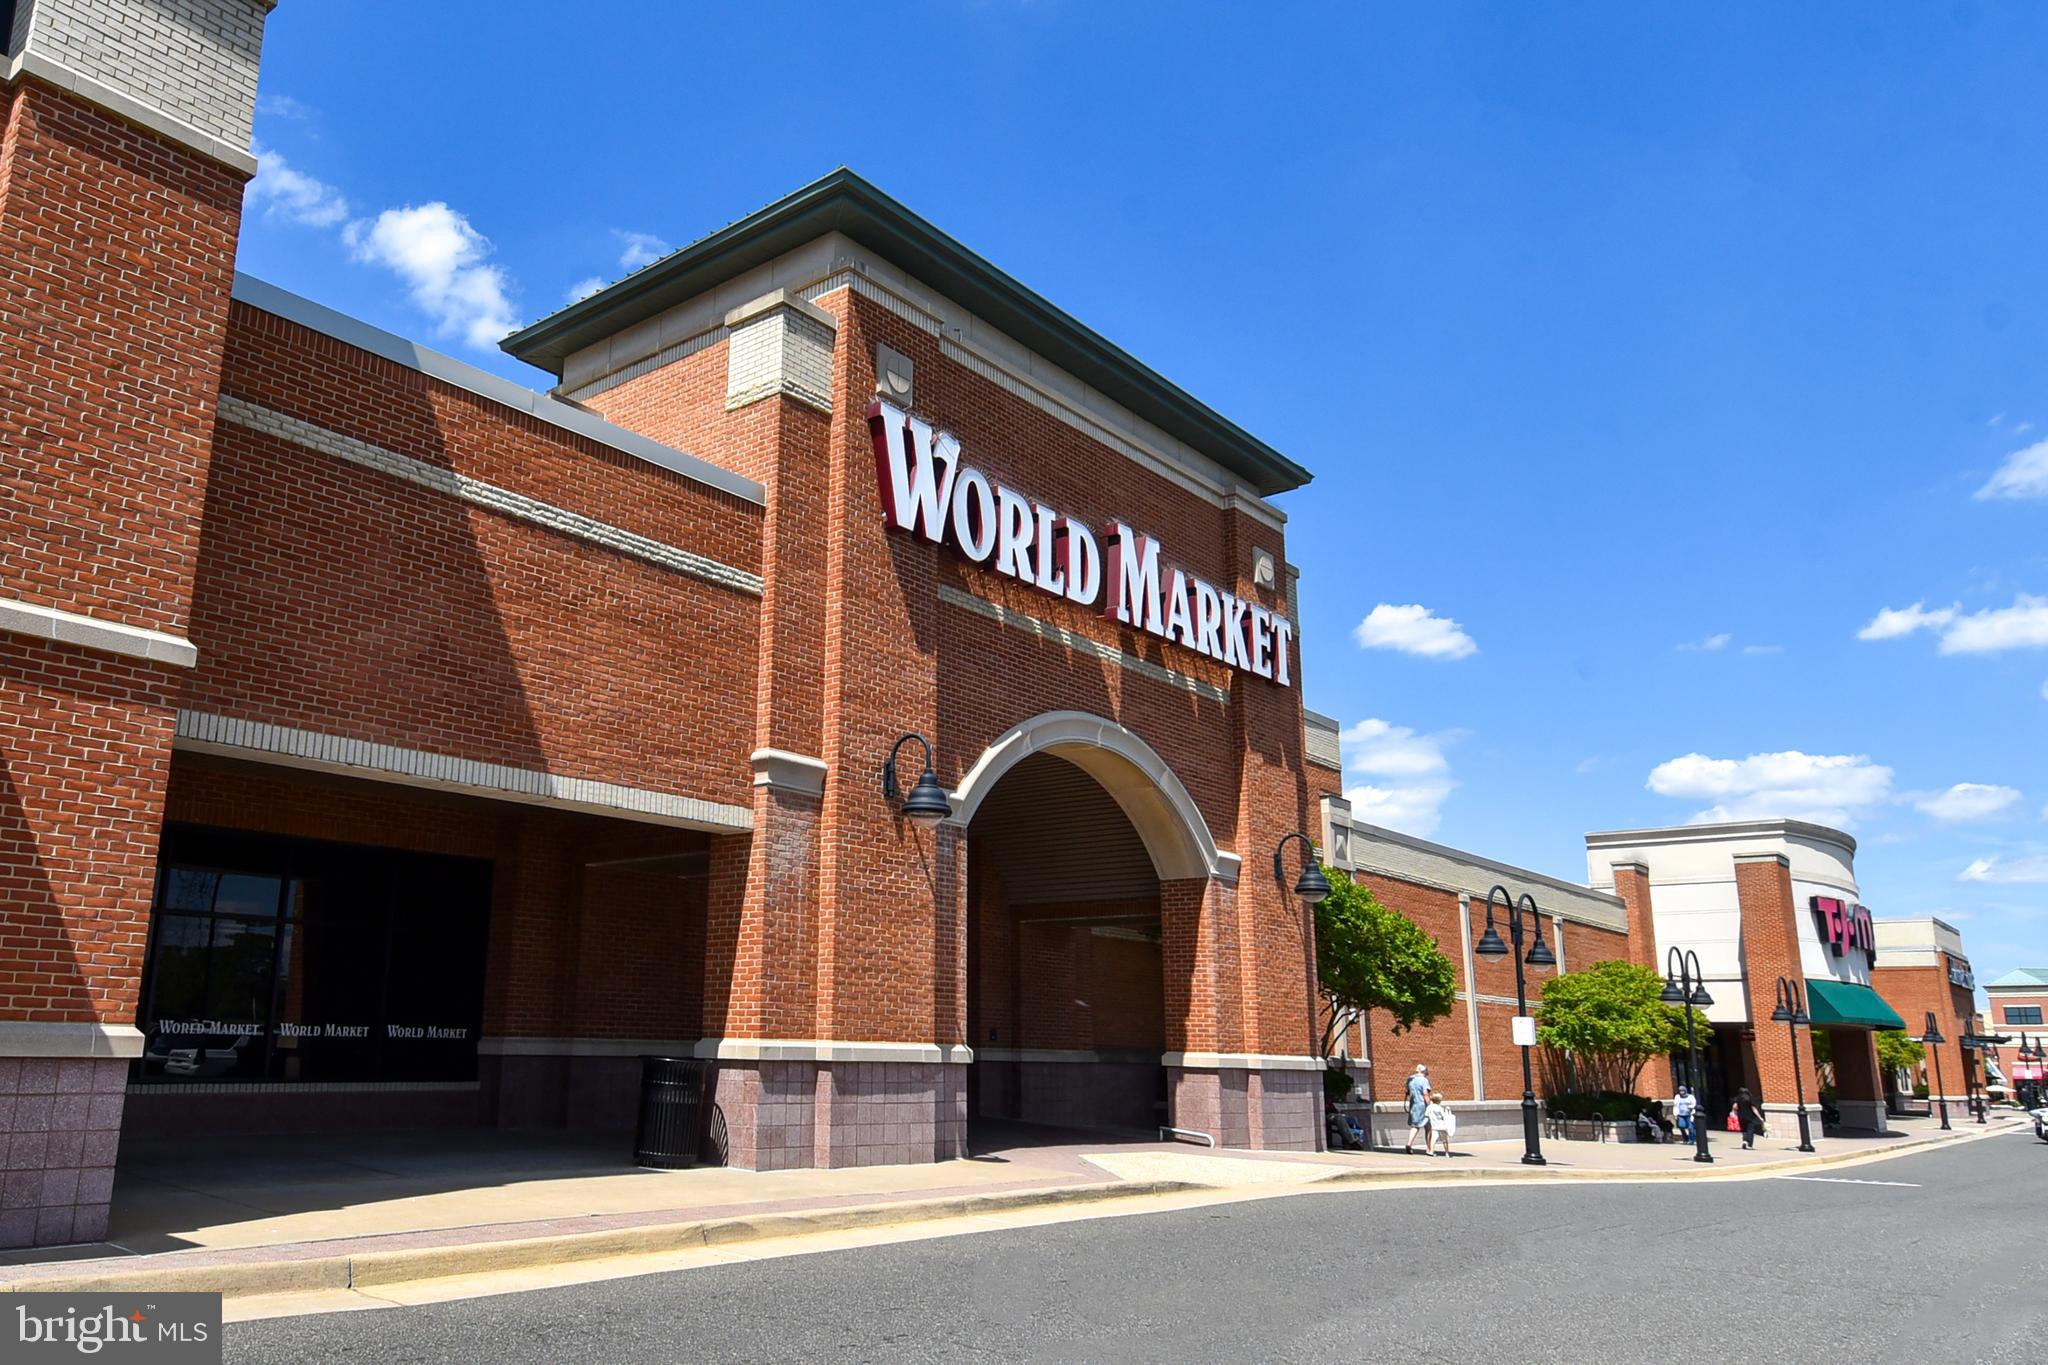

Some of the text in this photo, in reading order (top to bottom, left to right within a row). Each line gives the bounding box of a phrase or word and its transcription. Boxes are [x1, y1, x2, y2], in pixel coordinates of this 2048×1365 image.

[871, 401, 1292, 688] WORLD MARKET
[208, 1020, 260, 1036] MARKET
[280, 1022, 370, 1038] WORLD MARKET
[387, 1024, 467, 1039] WORLD MARKET
